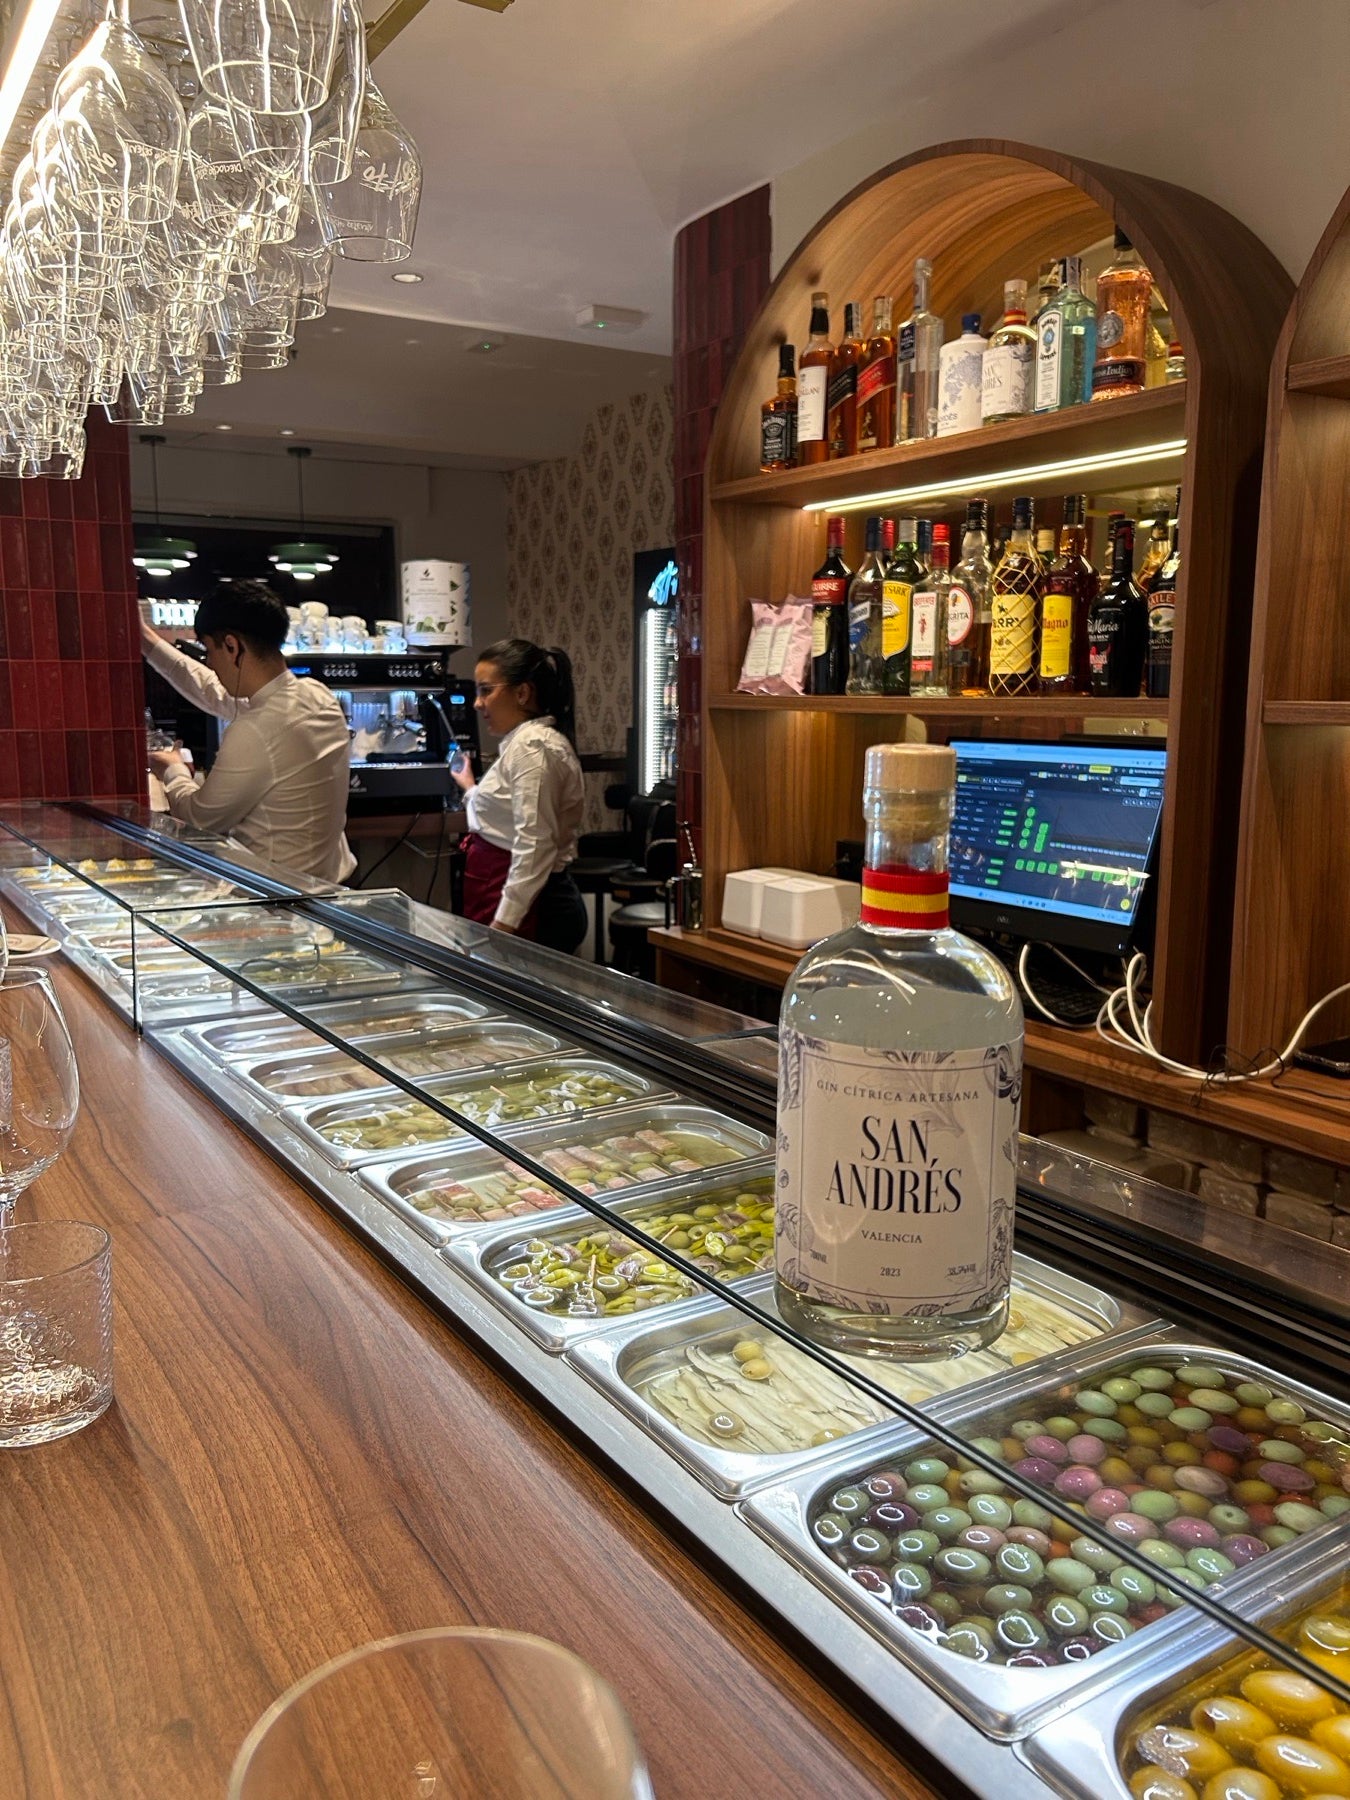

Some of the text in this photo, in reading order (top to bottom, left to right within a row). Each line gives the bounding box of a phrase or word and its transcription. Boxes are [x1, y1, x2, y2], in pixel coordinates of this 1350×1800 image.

[816, 1079, 979, 1103] GIN CÍTRICA ARTESANA
[861, 1115, 930, 1164] SAN
[825, 1158, 962, 1214] ANDRÉS
[861, 1230, 923, 1244] VALENCIA
[880, 1266, 901, 1277] 2023
